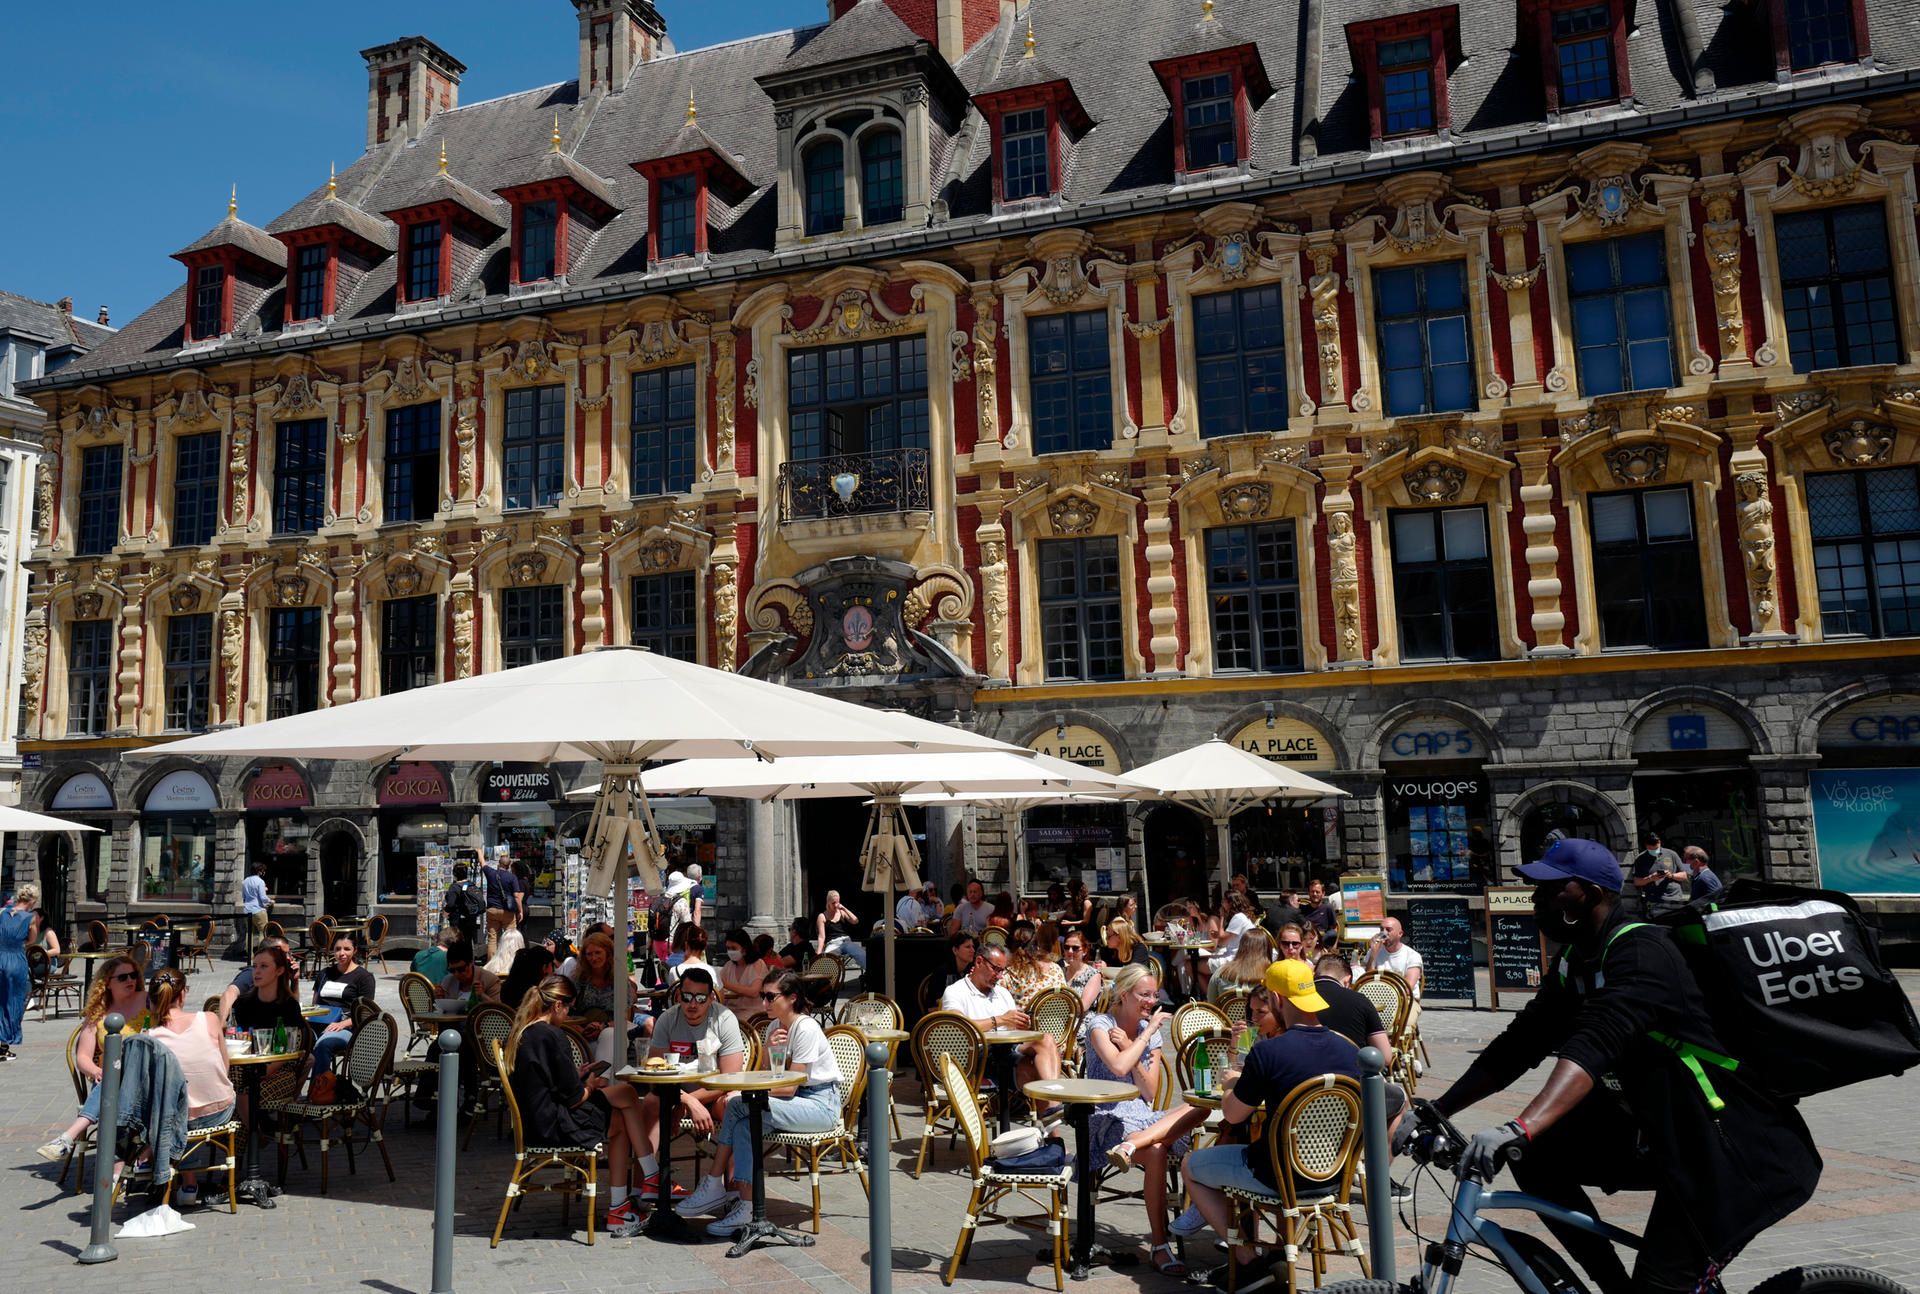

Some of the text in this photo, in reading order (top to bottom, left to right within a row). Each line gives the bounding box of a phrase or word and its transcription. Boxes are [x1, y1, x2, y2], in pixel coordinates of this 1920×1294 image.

[1851, 715, 1920, 741] CAP
[1241, 738, 1317, 752] LA PLACE
[1391, 729, 1473, 756] CAP 5
[1060, 745, 1104, 758] PLACE
[386, 780, 442, 796] KOKOA
[489, 773, 549, 787] SOUVENIRS
[252, 784, 303, 800] KOKOA
[512, 788, 538, 800] Lille
[1392, 781, 1478, 799] voyages
[1821, 783, 1895, 803] Voyage
[1832, 800, 1844, 808] by
[1489, 896, 1533, 904] LA PLACE
[1743, 930, 1845, 968] Uber
[1505, 969, 1523, 980] 8,90
[1757, 965, 1864, 1006] Eats
